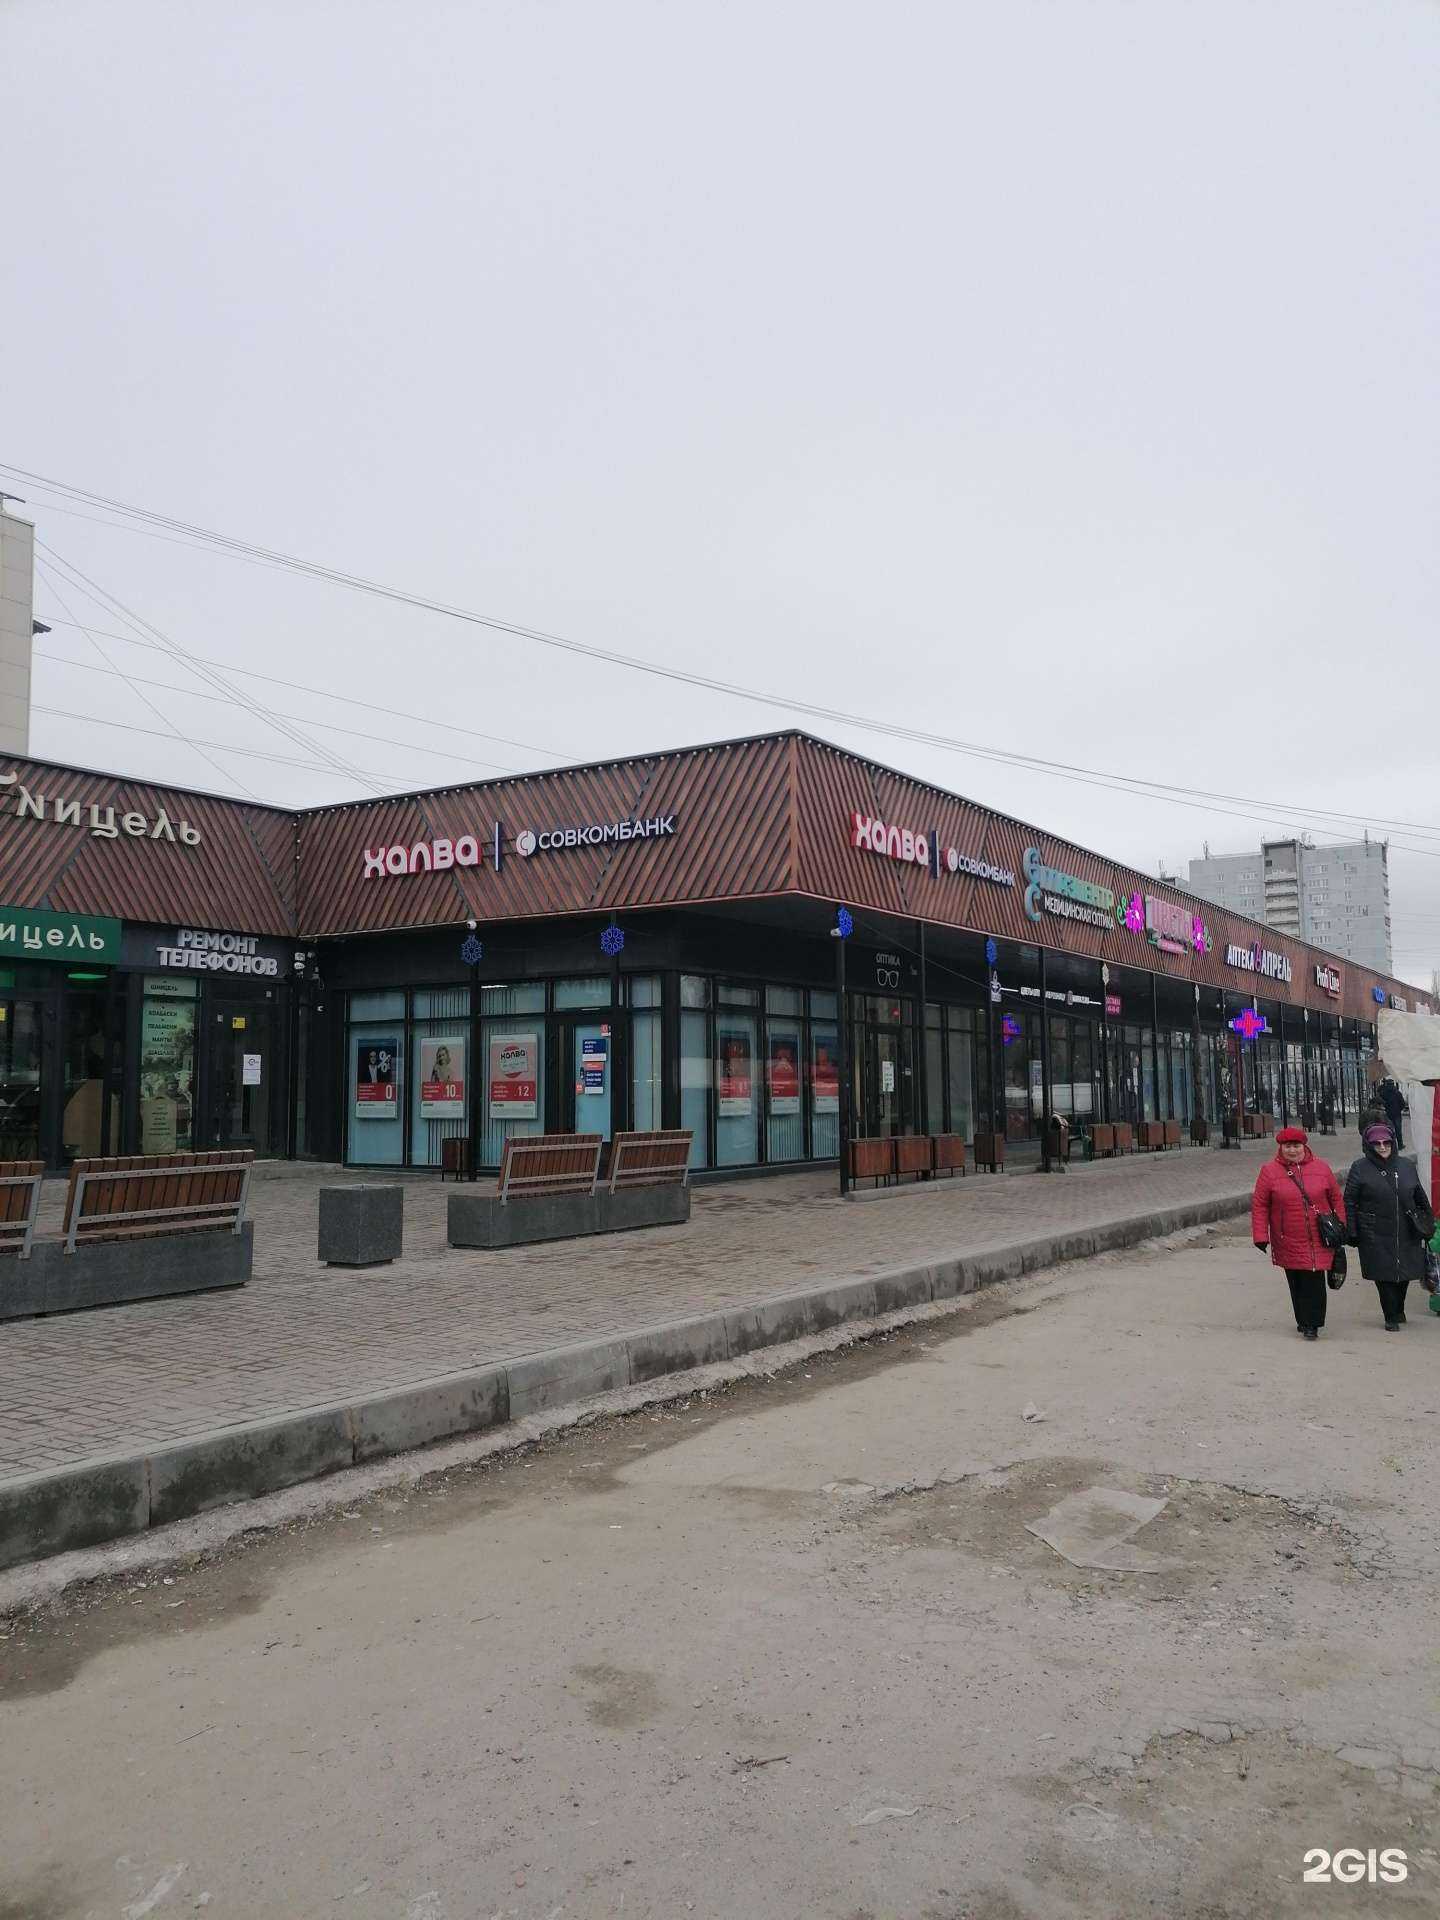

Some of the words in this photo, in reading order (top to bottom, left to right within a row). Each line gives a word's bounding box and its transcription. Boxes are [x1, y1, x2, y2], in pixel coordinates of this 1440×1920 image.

[538, 815, 675, 850] СОВКОМБАНК
[958, 854, 1016, 887] СОВКОМБАНК
[1044, 894, 1091, 925] МЕДИЦИНСКАЯ
[1091, 911, 1115, 931] ОПТИКА
[178, 929, 259, 955] РЕМОНТ
[157, 946, 278, 976] ТЕЛЕФОНОВ
[875, 952, 901, 966] ОПТИКА
[1225, 943, 1255, 972] АПТЕКА
[1260, 948, 1292, 983] АПРЕЛЬ
[445, 1084, 456, 1098] 10
